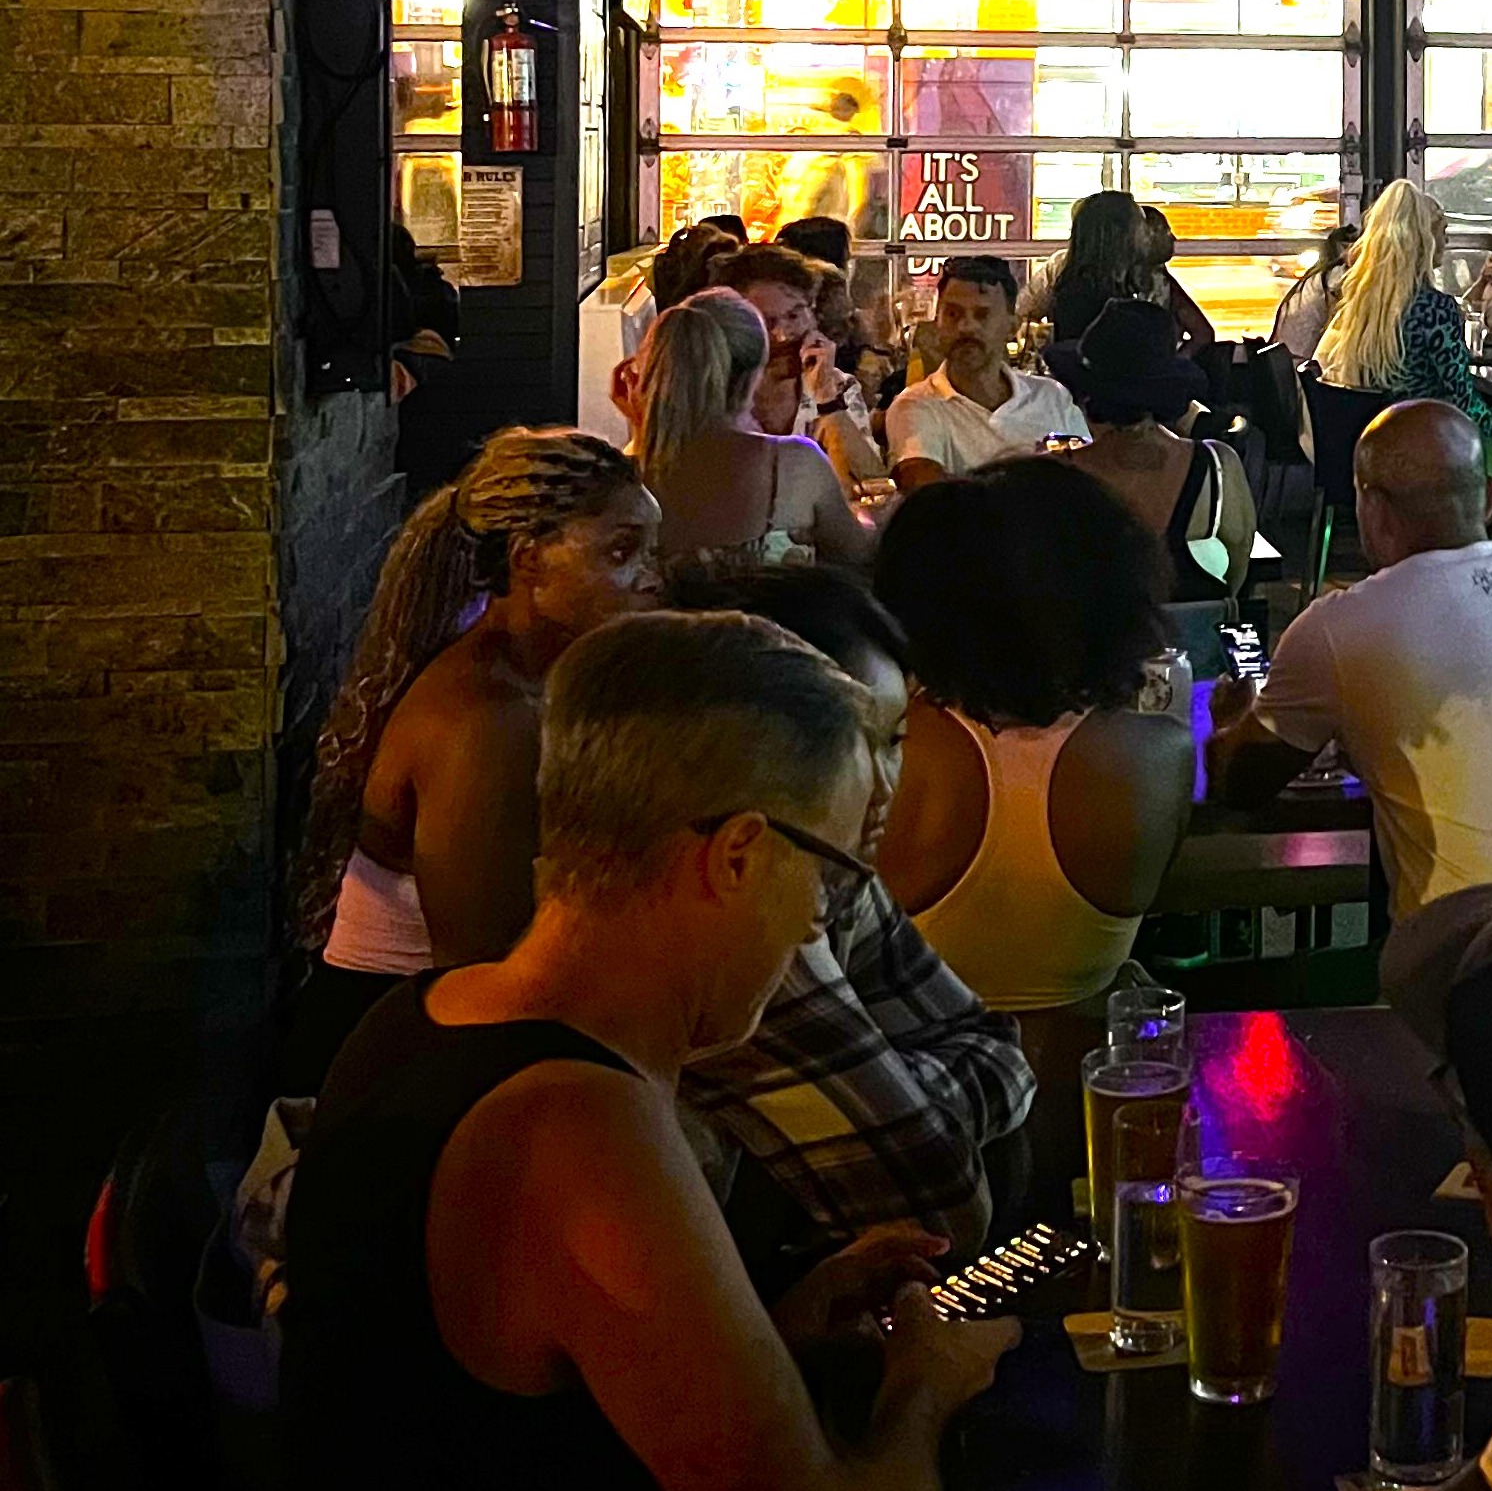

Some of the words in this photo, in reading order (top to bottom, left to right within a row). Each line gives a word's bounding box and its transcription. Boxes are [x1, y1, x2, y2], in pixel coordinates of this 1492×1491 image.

[922, 152, 980, 182] IT'S
[917, 182, 984, 213] ALL
[899, 214, 1014, 241] ABOUT
